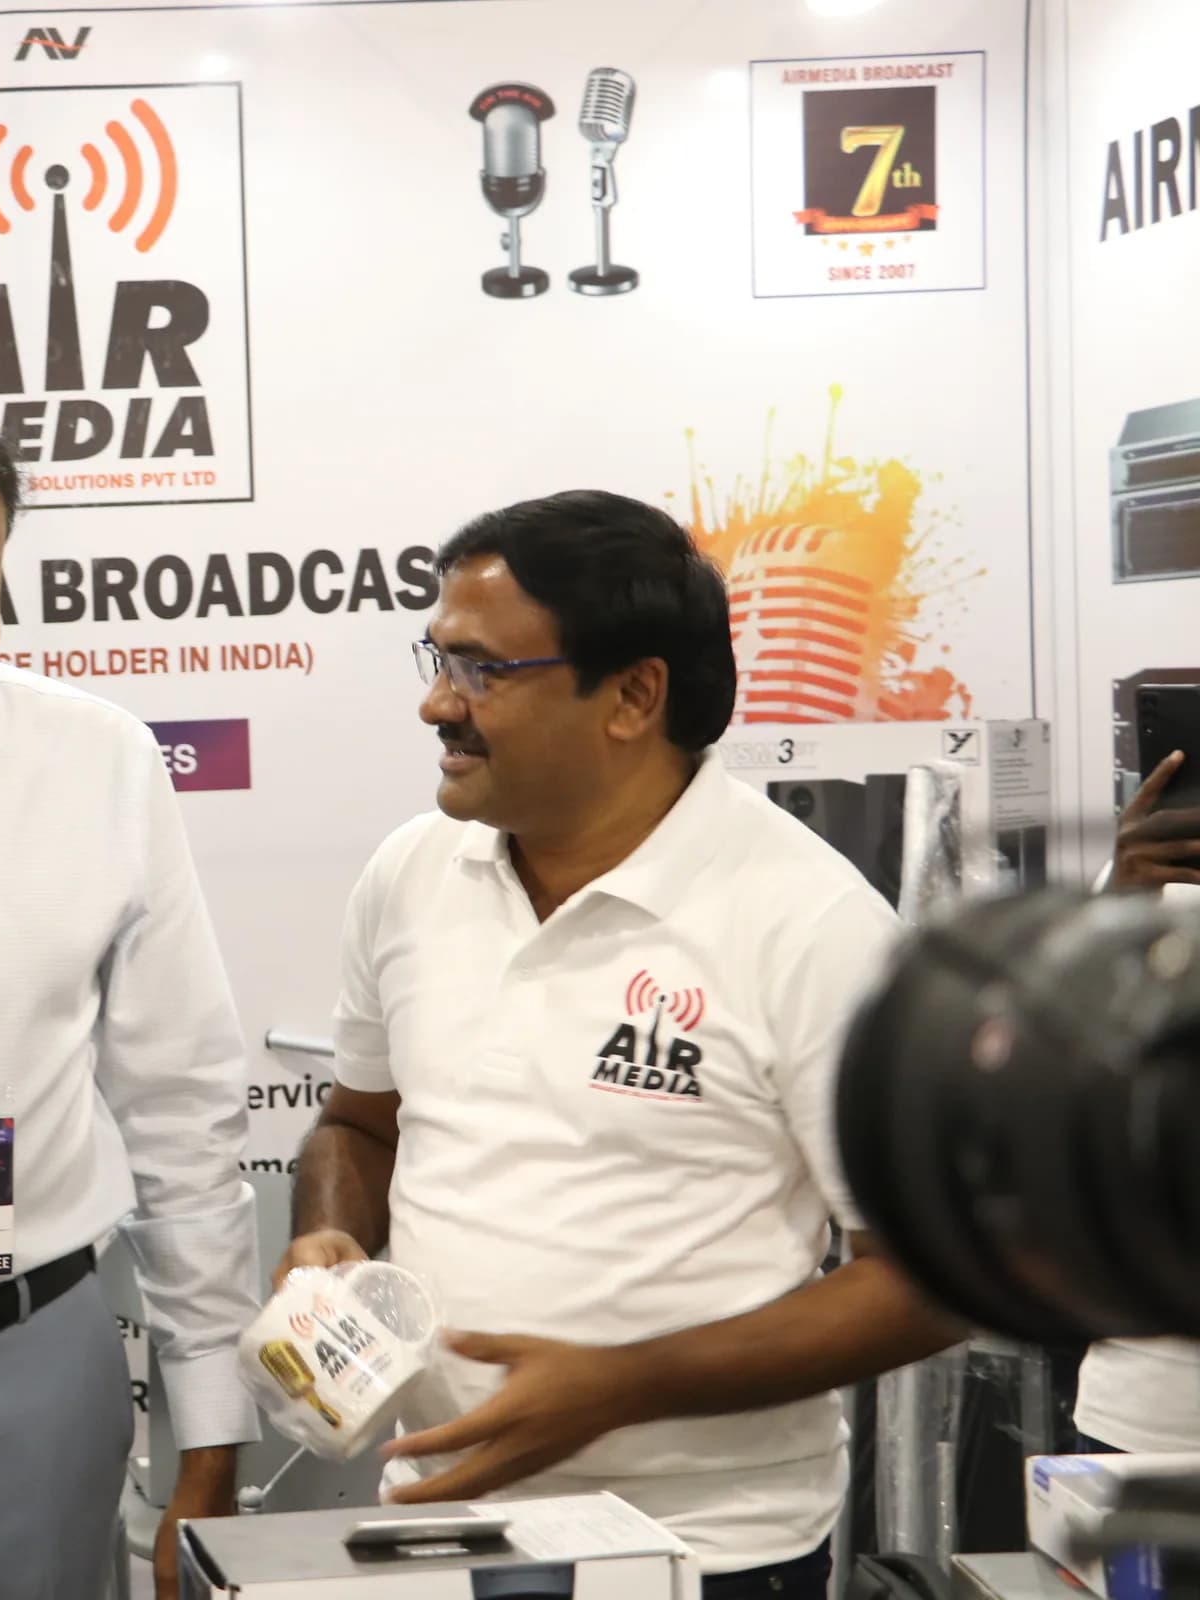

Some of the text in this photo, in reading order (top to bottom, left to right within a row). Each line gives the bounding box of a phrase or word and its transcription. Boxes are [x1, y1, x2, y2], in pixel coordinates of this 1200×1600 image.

[782, 63, 954, 84] AIRMEDIA BROADCAST
[828, 263, 915, 281] SINCE 2007
[28, 470, 216, 491] SOLUTIONS PVT LTD
[41, 546, 441, 624] BROADCAS
[43, 647, 168, 678] HOLDER
[180, 646, 209, 673] IN
[220, 642, 314, 676] INDIA)
[160, 743, 197, 775] ES
[596, 1002, 703, 1079] AIR
[247, 1073, 332, 1110] ervic
[592, 1060, 702, 1097] MEDIA
